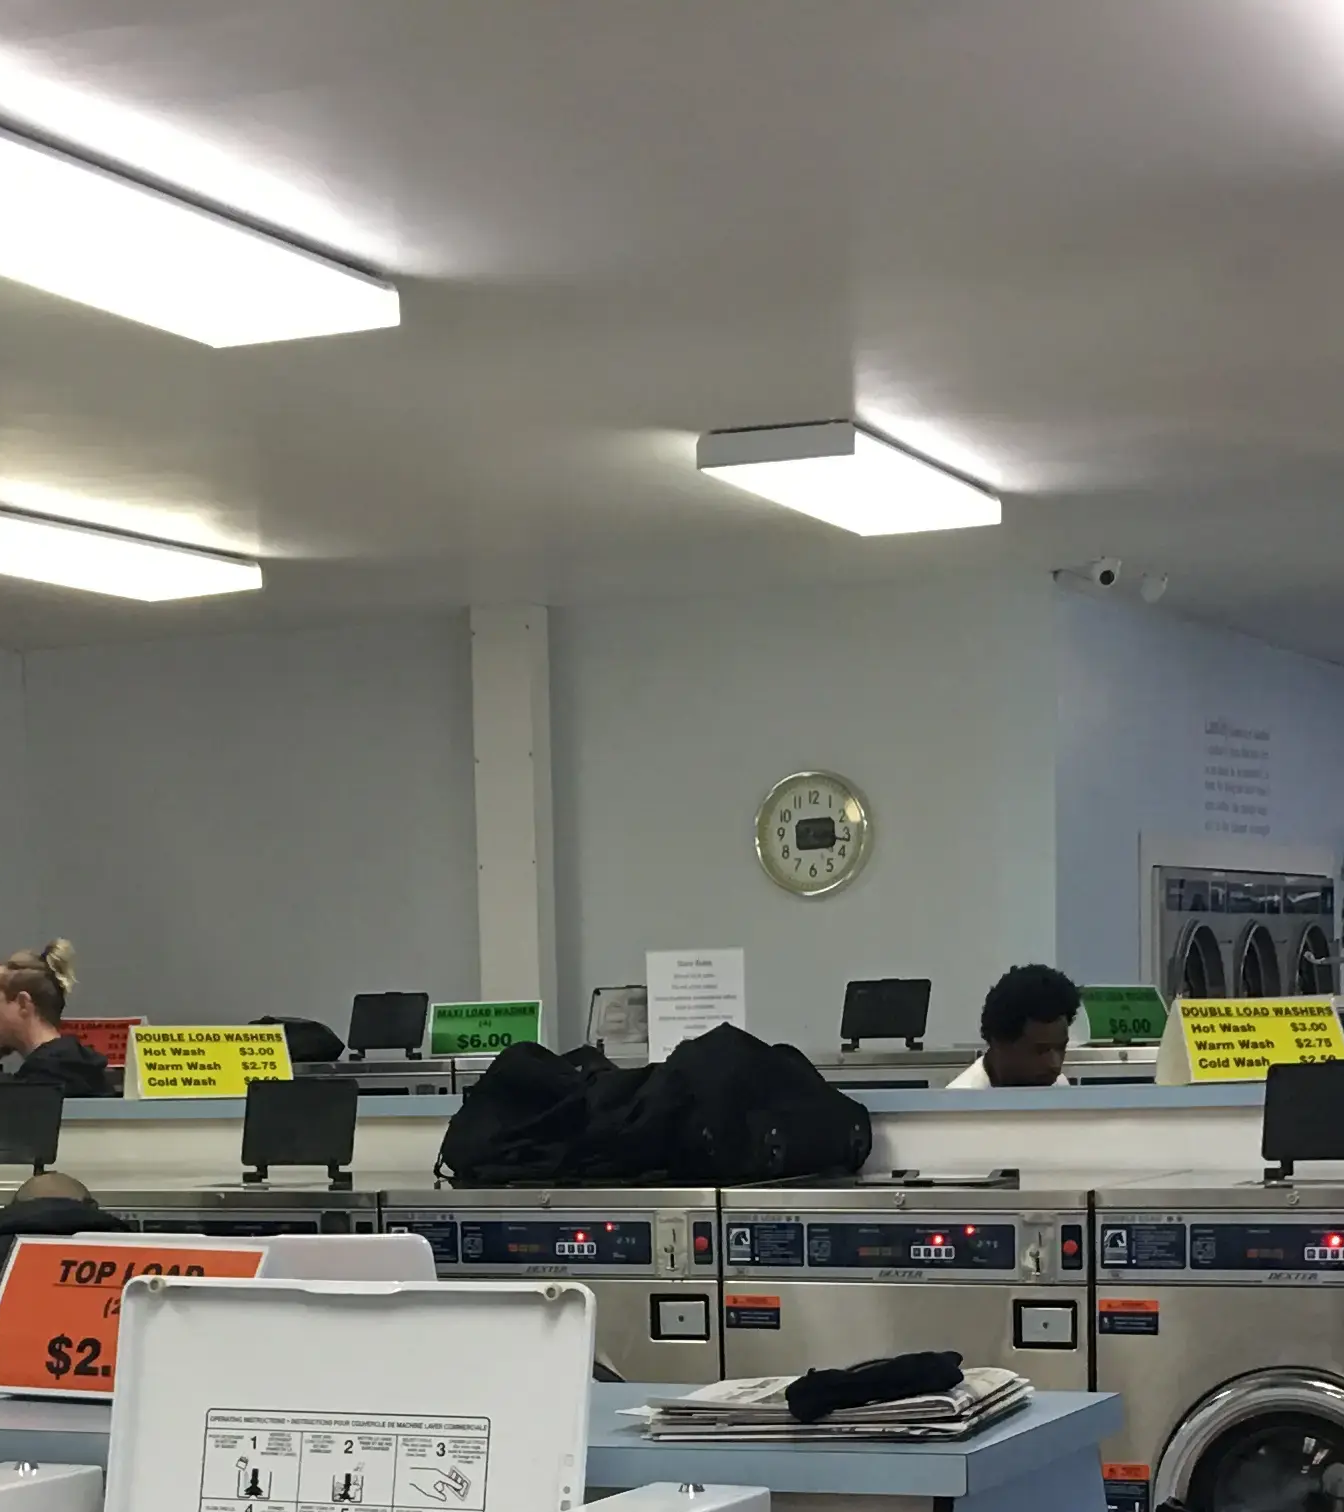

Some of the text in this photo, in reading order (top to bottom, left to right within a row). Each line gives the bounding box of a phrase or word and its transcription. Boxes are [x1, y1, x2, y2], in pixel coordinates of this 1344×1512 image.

[794, 795, 802, 809] 11
[808, 790, 820, 805] 12
[780, 809, 792, 824] 10
[839, 809, 846, 823] 2
[777, 827, 785, 841] 9
[842, 826, 851, 842] 3
[782, 845, 790, 859] 8
[838, 845, 846, 858] 4
[794, 858, 802, 872] 7
[809, 863, 817, 878] 6
[826, 858, 834, 873] 5
[437, 1009, 463, 1019] MAXI
[465, 1008, 491, 1018] LOAD
[1181, 1006, 1333, 1017] DOUBLE LOAD WASHERS
[1109, 1018, 1151, 1034] $6.00
[1191, 1022, 1327, 1034] Hot Wash $3.00
[136, 1032, 283, 1042] DOUBLE LOAD WASHERS
[457, 1033, 512, 1049] $6.00
[144, 1046, 274, 1057] Hot Wash $3.00
[1194, 1038, 1332, 1051] Warm Wash $2.75
[145, 1061, 277, 1071] Warm Wash $2.75
[1199, 1058, 1230, 1069] Cold
[1233, 1056, 1270, 1067] Wash
[148, 1077, 216, 1087] Cold Wash
[60, 1260, 117, 1284] TOP
[526, 1265, 568, 1273] DEXTER
[878, 1270, 923, 1279] DEXTER
[1268, 1272, 1318, 1280] DEXTER
[45, 1333, 112, 1380] $2.
[250, 1436, 257, 1449] 1
[343, 1440, 353, 1454] 2
[436, 1442, 446, 1457] 3
